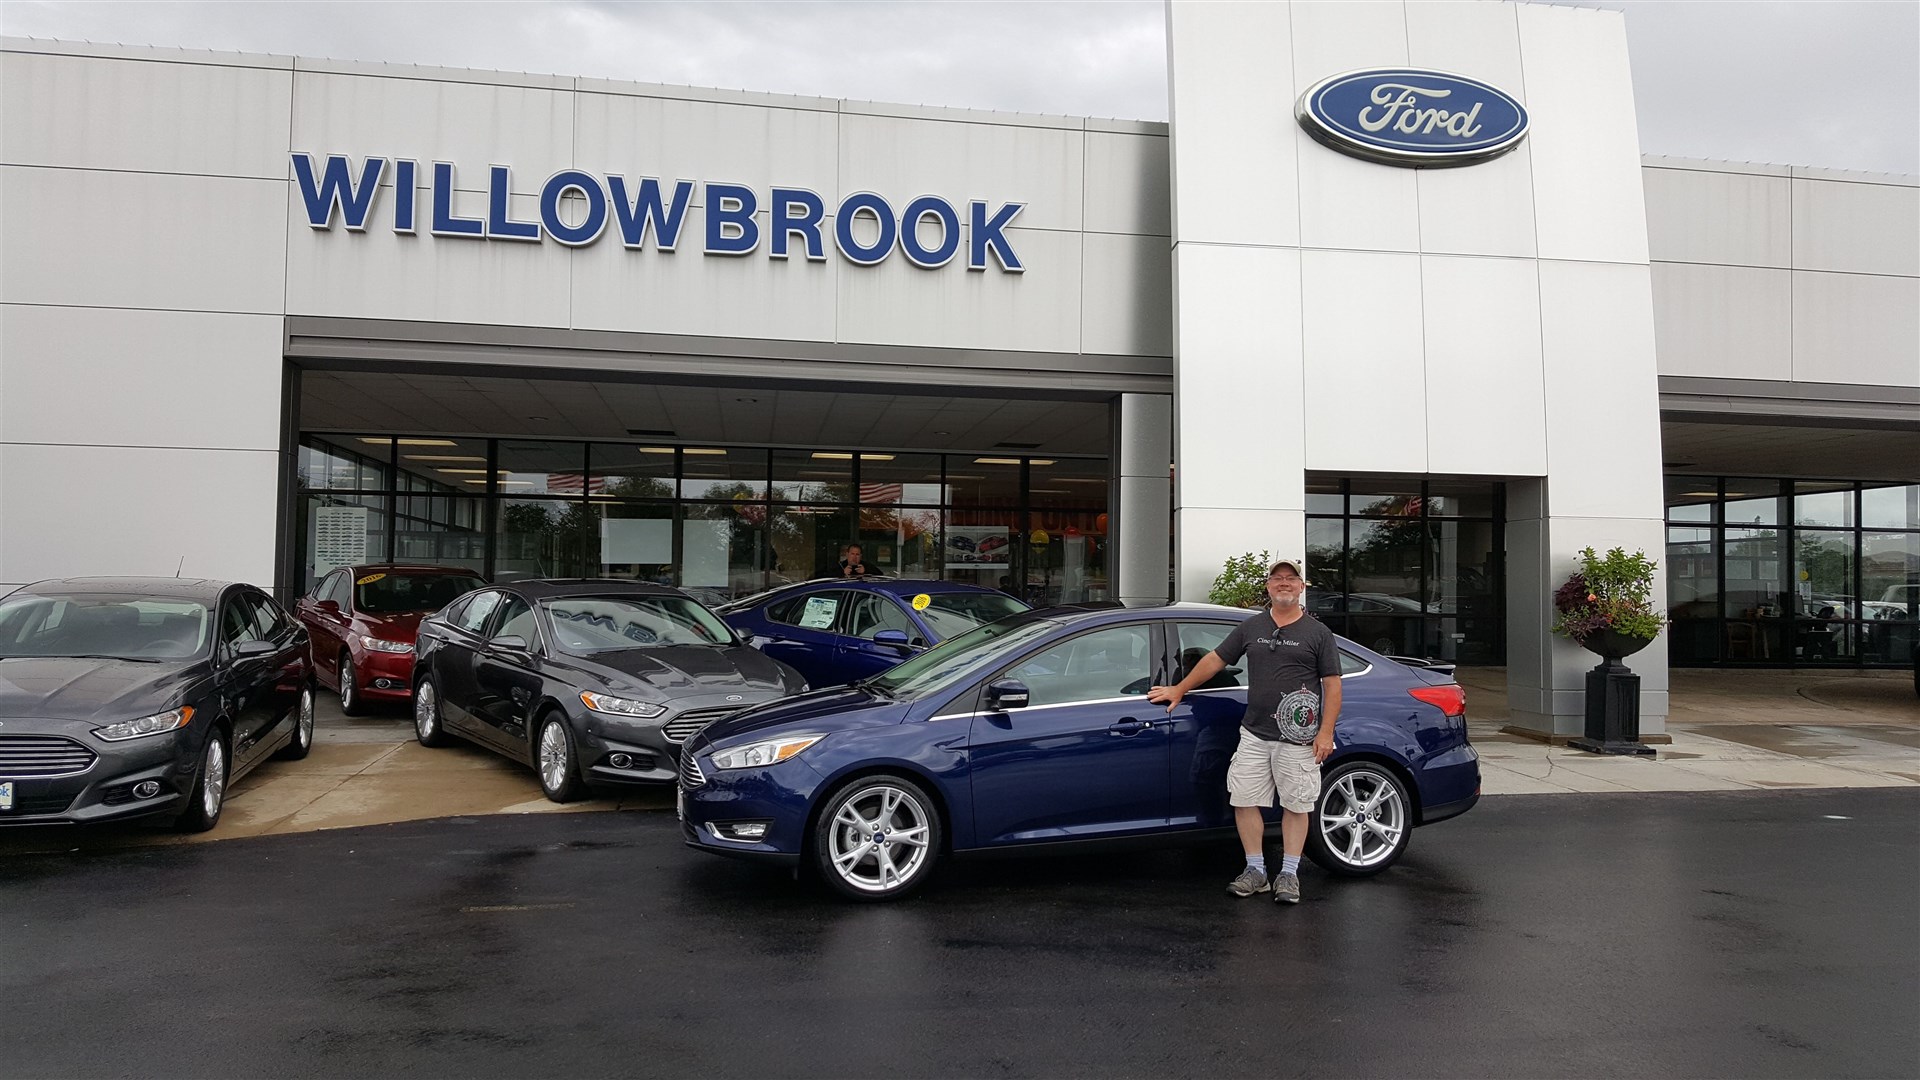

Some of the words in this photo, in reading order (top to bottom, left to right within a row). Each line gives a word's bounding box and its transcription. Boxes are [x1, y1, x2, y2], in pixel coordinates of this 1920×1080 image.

[1357, 83, 1483, 138] Ford
[288, 152, 1027, 274] WILLOWBROOK
[1257, 637, 1273, 645] Cinc
